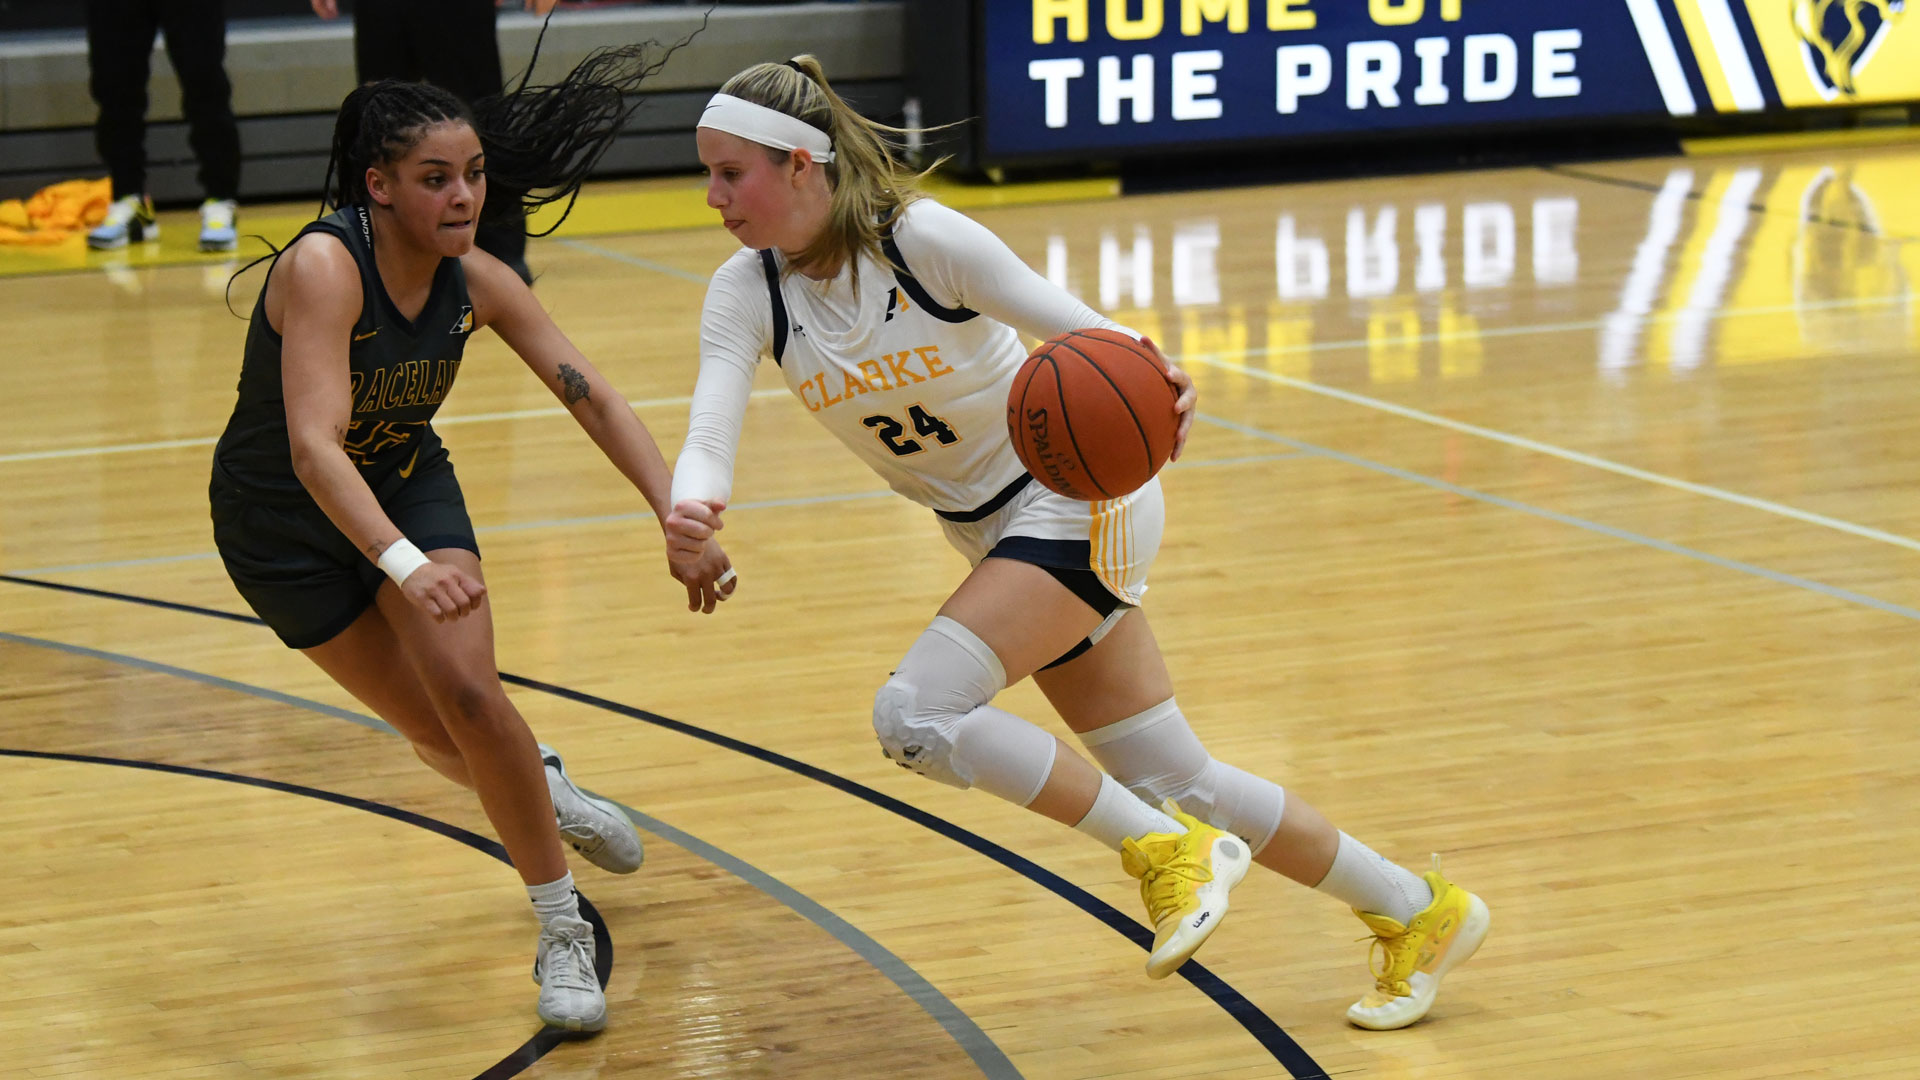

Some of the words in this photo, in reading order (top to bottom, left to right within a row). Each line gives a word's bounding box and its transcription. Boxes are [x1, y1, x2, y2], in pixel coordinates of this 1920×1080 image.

[1028, 50, 1223, 128] THE
[1276, 28, 1583, 114] PRIDE
[799, 345, 955, 412] CLARKE
[859, 401, 963, 458] 24
